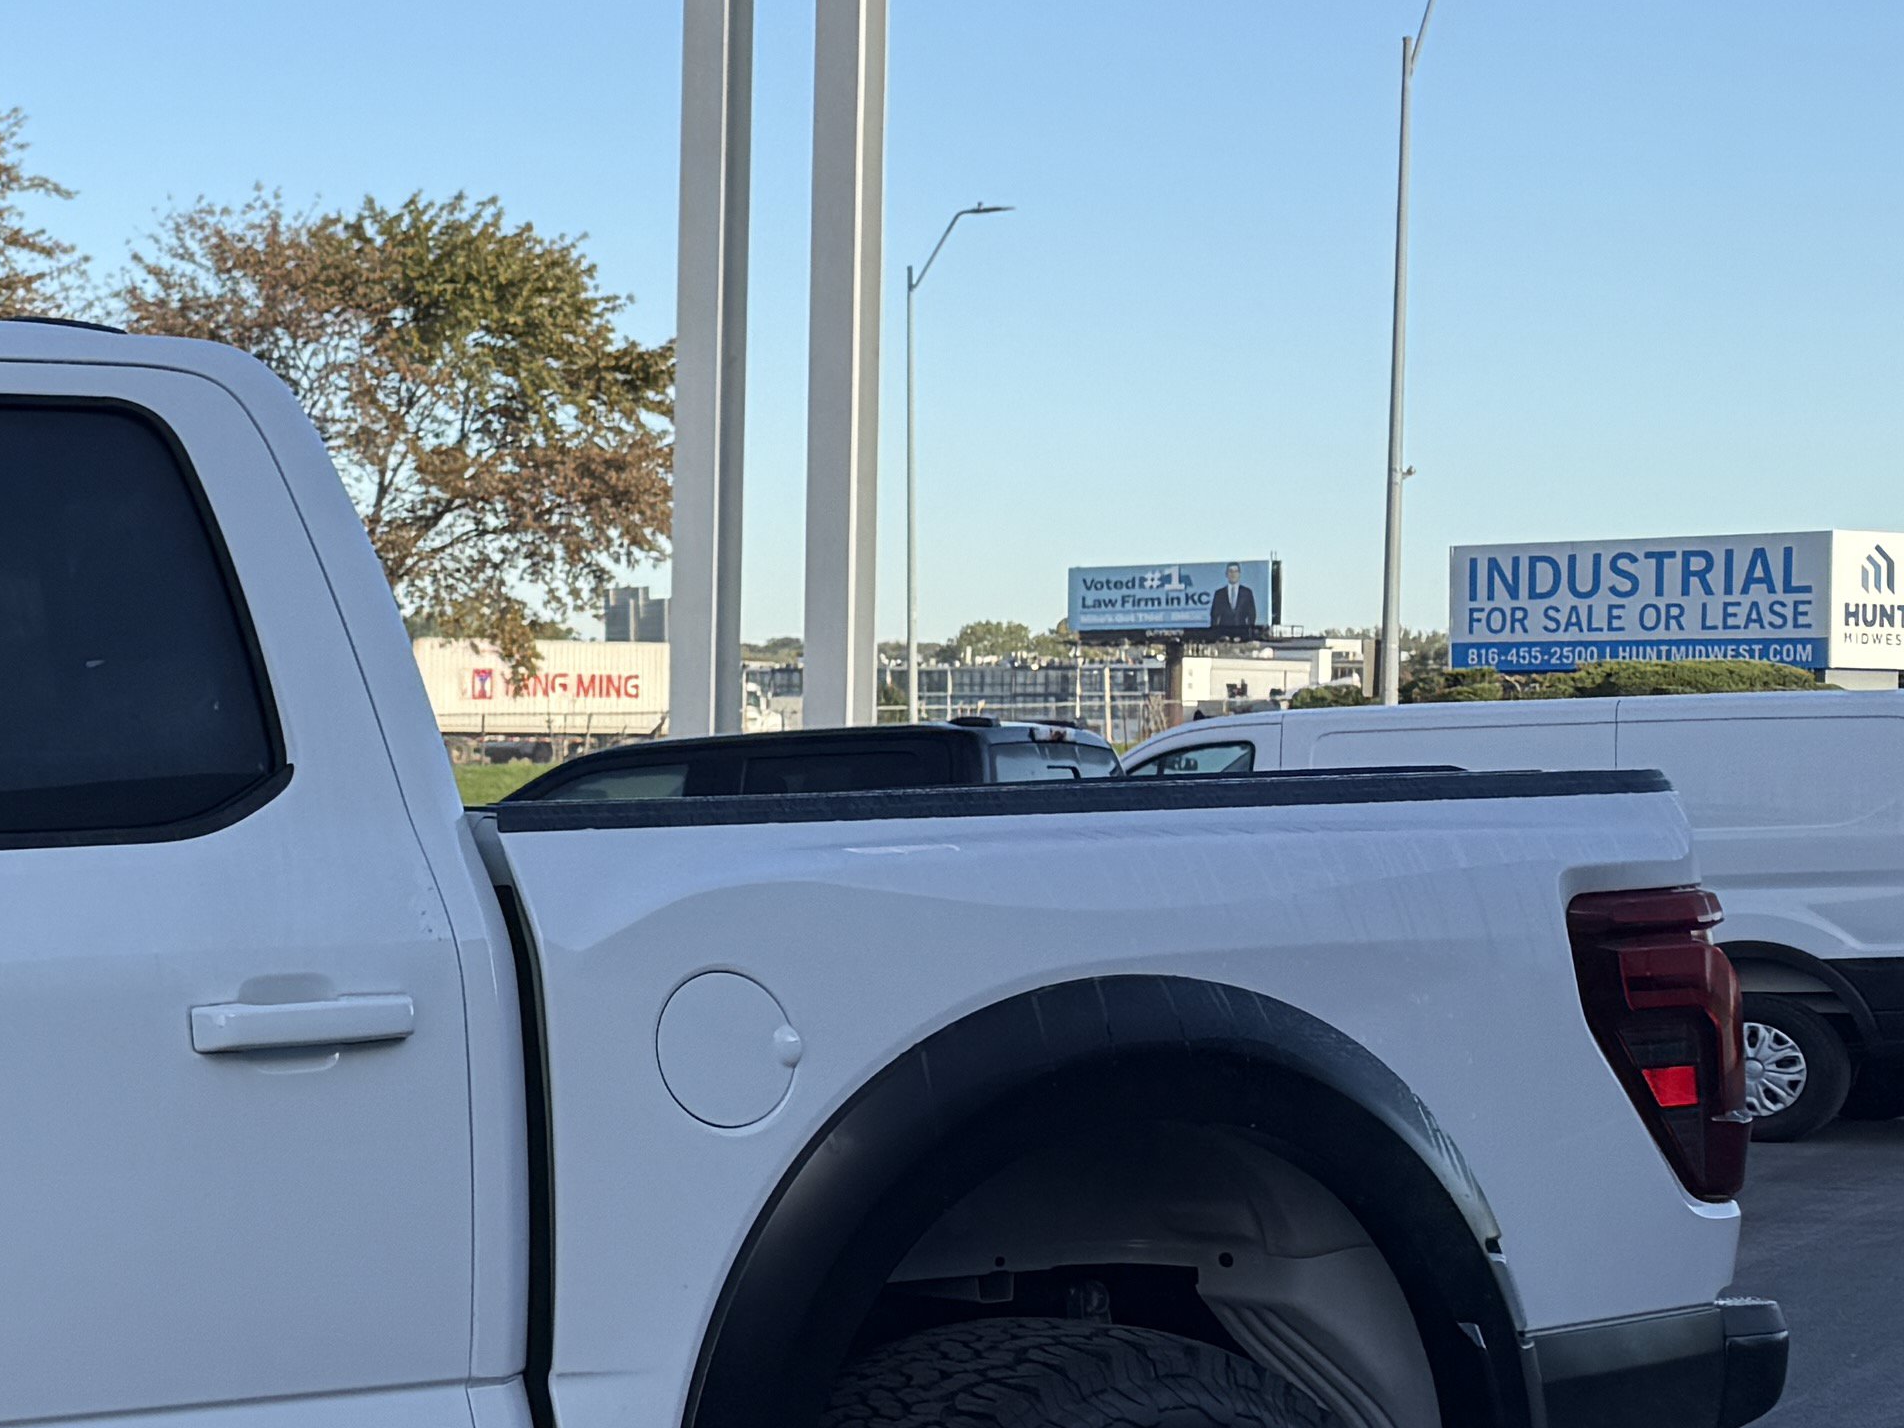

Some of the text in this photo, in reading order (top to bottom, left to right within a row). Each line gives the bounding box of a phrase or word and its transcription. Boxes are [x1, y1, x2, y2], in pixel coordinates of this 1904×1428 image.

[1082, 566, 1186, 592] Voted #1
[1467, 545, 1814, 602] INDUSTRIAL
[1081, 592, 1211, 610] Law Firm in KC
[1467, 600, 1814, 635] FOR SALE OR LEASE
[1844, 632, 1903, 646] MIDWES
[1467, 646, 1598, 665] 816-455-2500
[575, 673, 640, 699] MING
